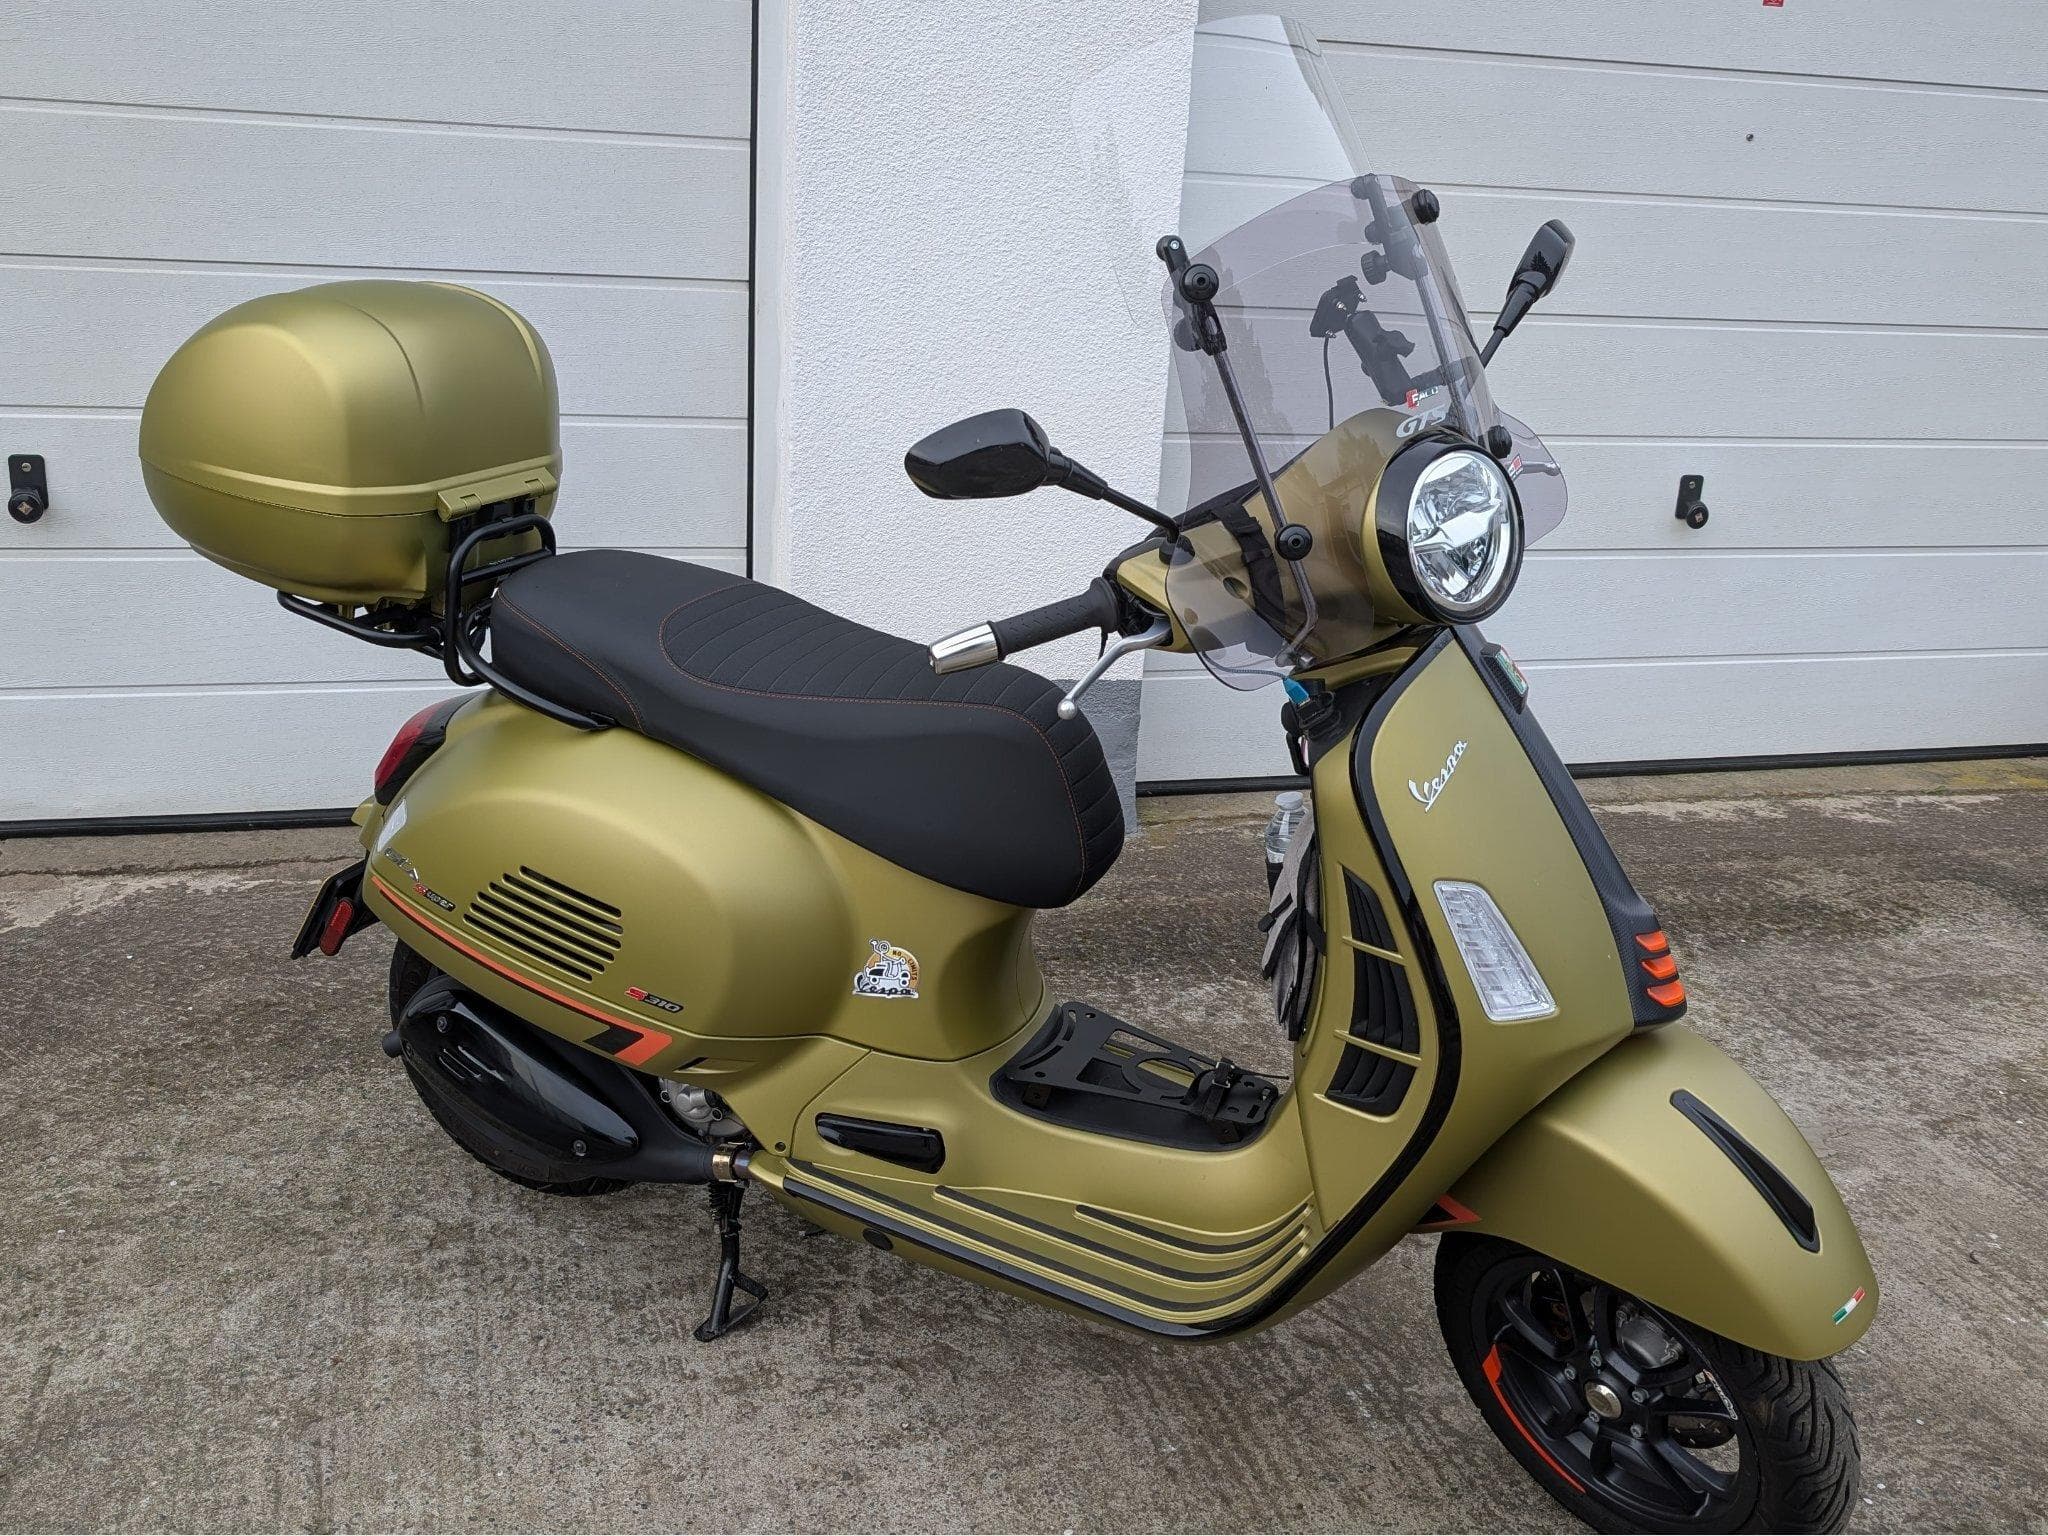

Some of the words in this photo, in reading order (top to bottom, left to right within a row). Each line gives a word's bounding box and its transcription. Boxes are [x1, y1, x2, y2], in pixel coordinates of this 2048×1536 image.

[1396, 404, 1446, 438] GTS
[1408, 740, 1468, 813] Vespa
[892, 949, 902, 957] NO
[907, 958, 918, 981] LIMITS
[855, 974, 916, 997] Vespa
